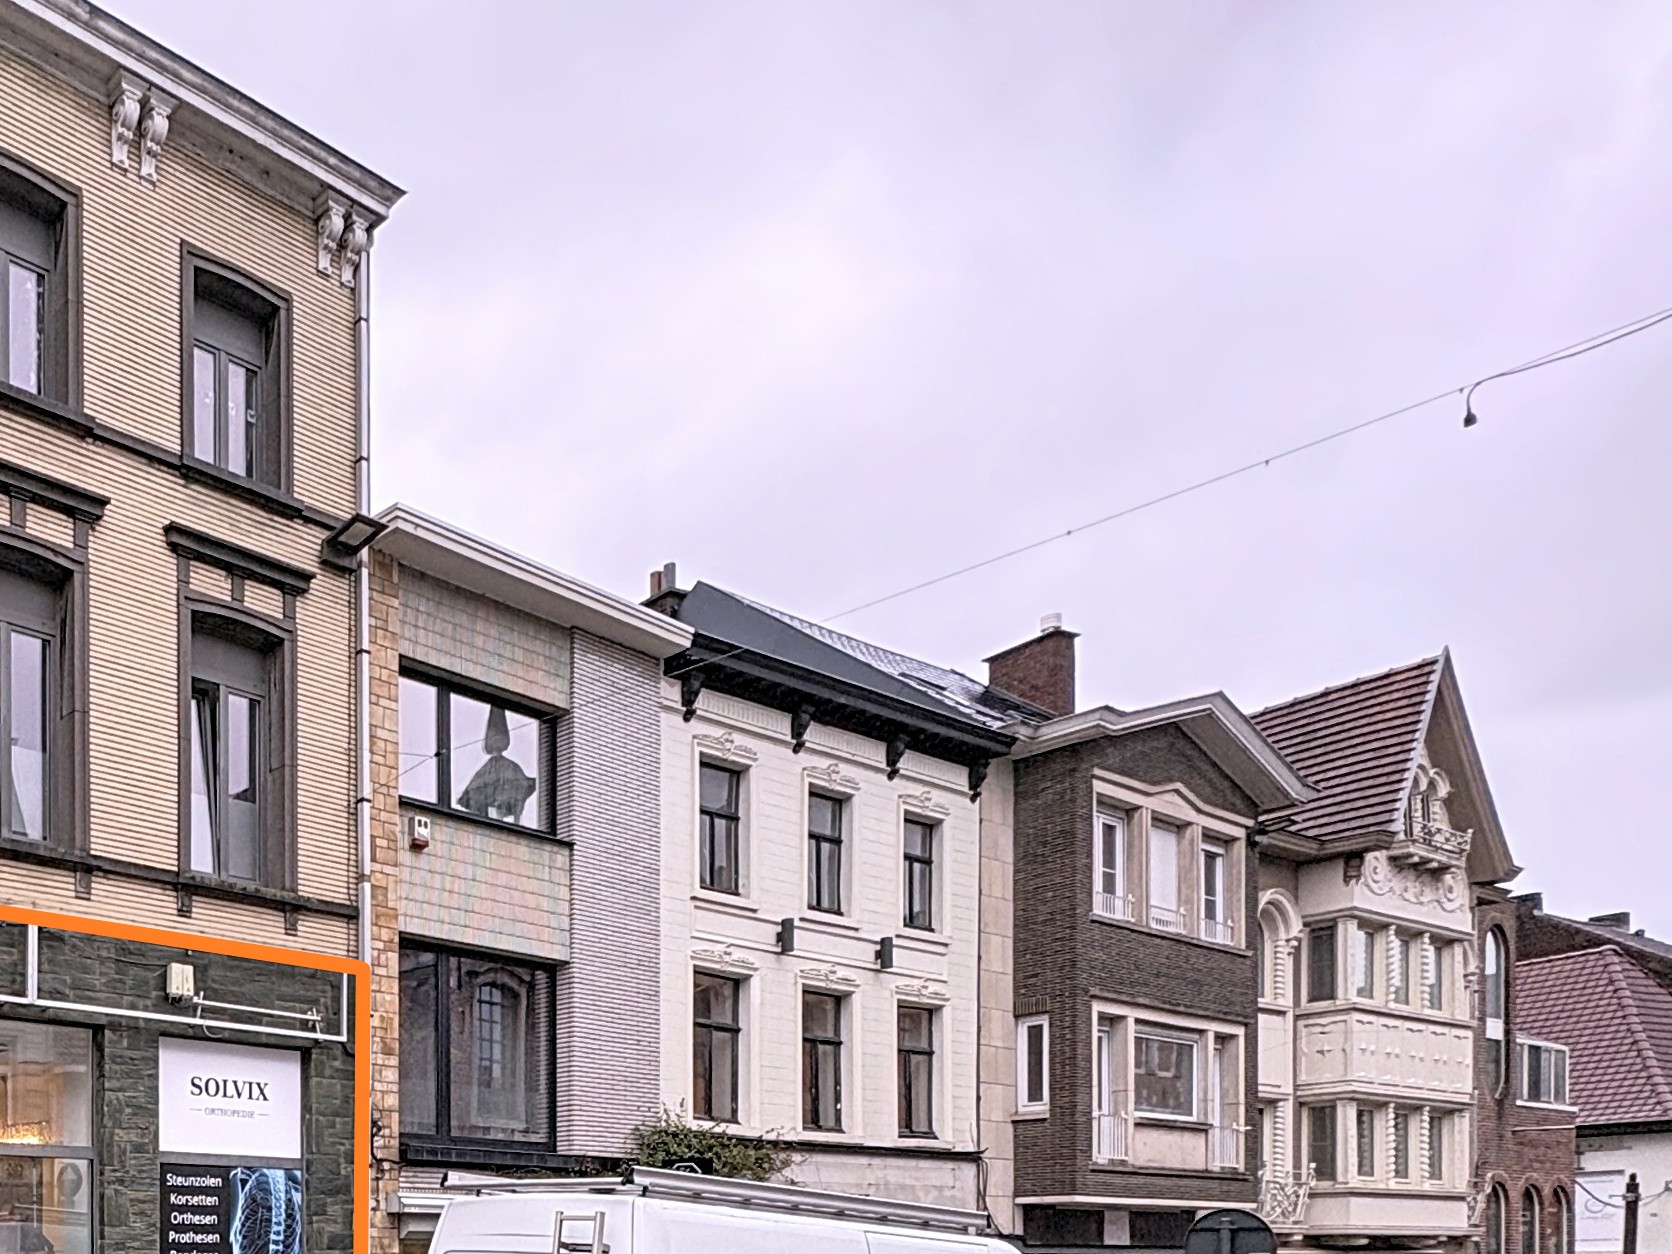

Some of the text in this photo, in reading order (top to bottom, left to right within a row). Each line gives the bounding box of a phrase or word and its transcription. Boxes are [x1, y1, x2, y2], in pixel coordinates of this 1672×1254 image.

[190, 1075, 270, 1102] SOLVIX
[166, 1173, 222, 1187] Steunzolen
[169, 1193, 219, 1206] Korsetten
[170, 1212, 218, 1225] Orthesen
[169, 1231, 220, 1244] Prothesen
